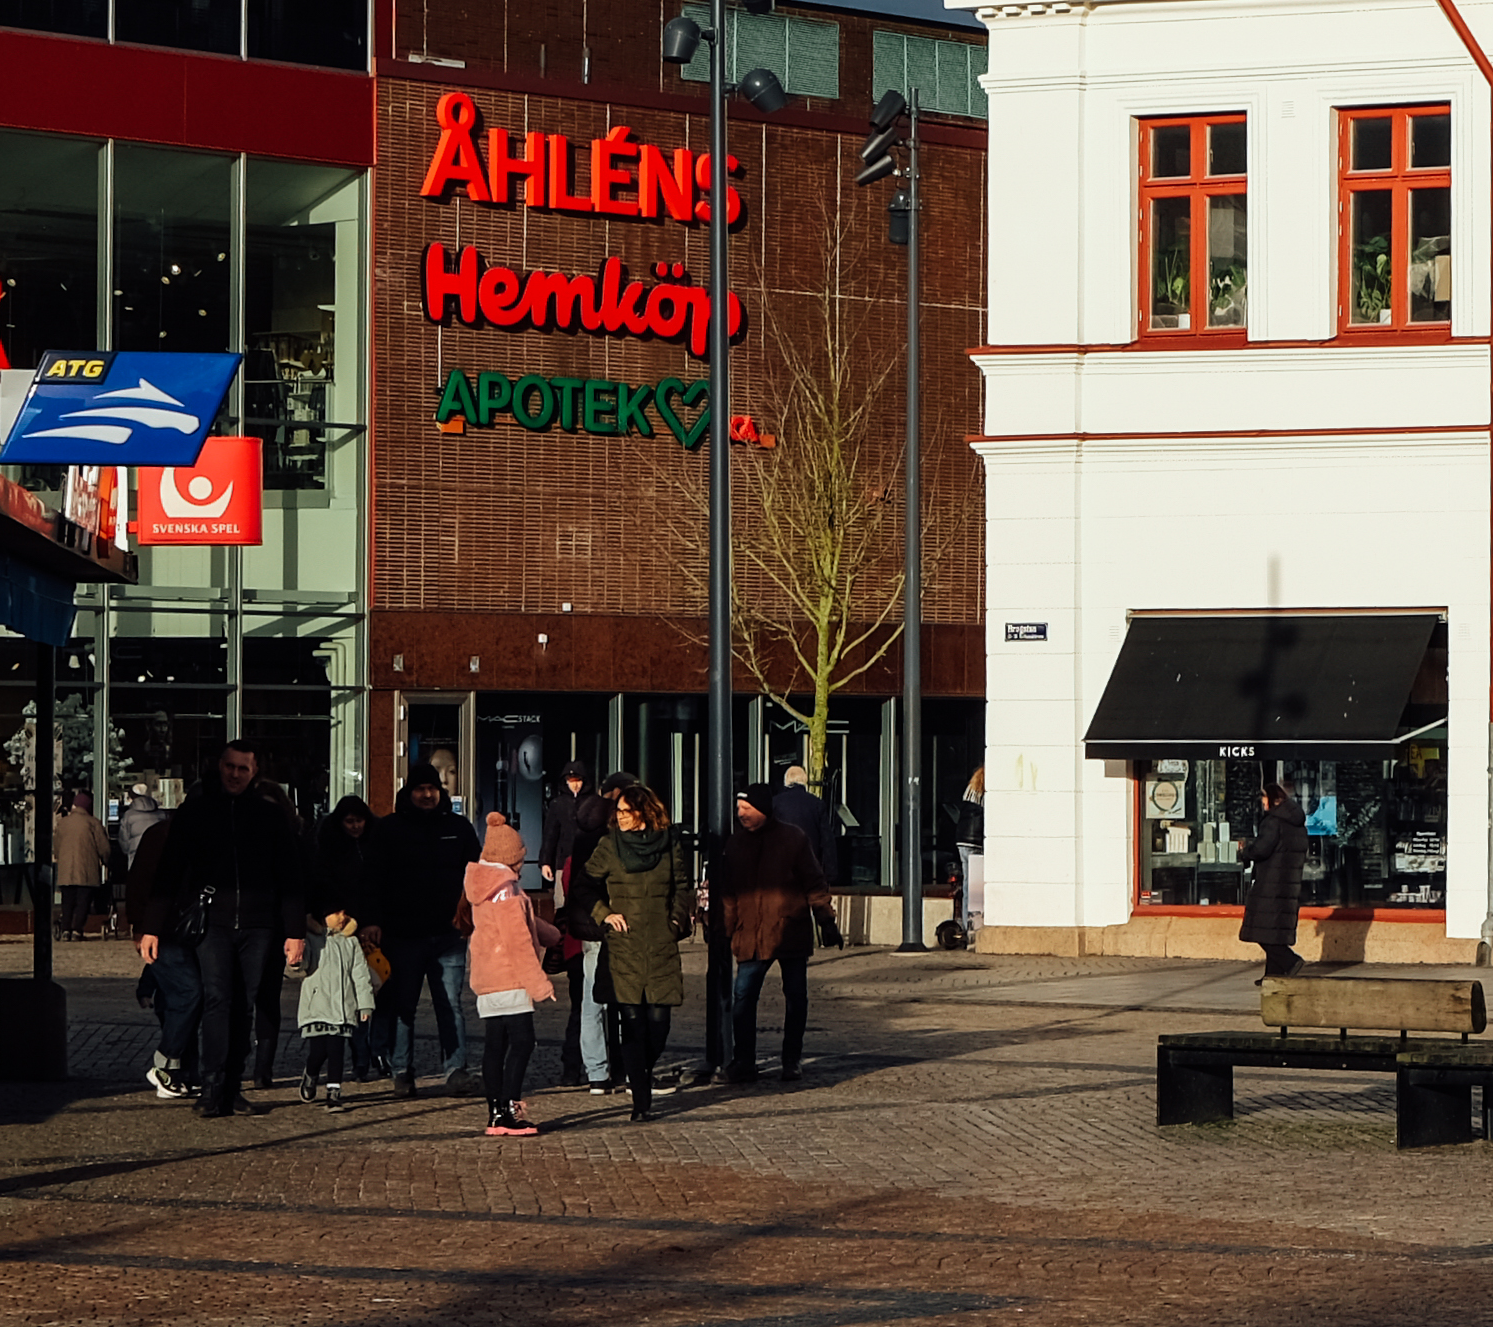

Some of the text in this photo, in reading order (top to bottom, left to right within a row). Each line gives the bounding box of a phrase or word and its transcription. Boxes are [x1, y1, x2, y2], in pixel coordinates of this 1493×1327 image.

[420, 91, 742, 225] ÅHLÉNS
[425, 242, 743, 356] Hemköp
[46, 359, 105, 379] ATG
[436, 369, 654, 436] APOTEK
[152, 523, 240, 534] SVENSKA SPEL
[1219, 746, 1256, 758] KICKS
